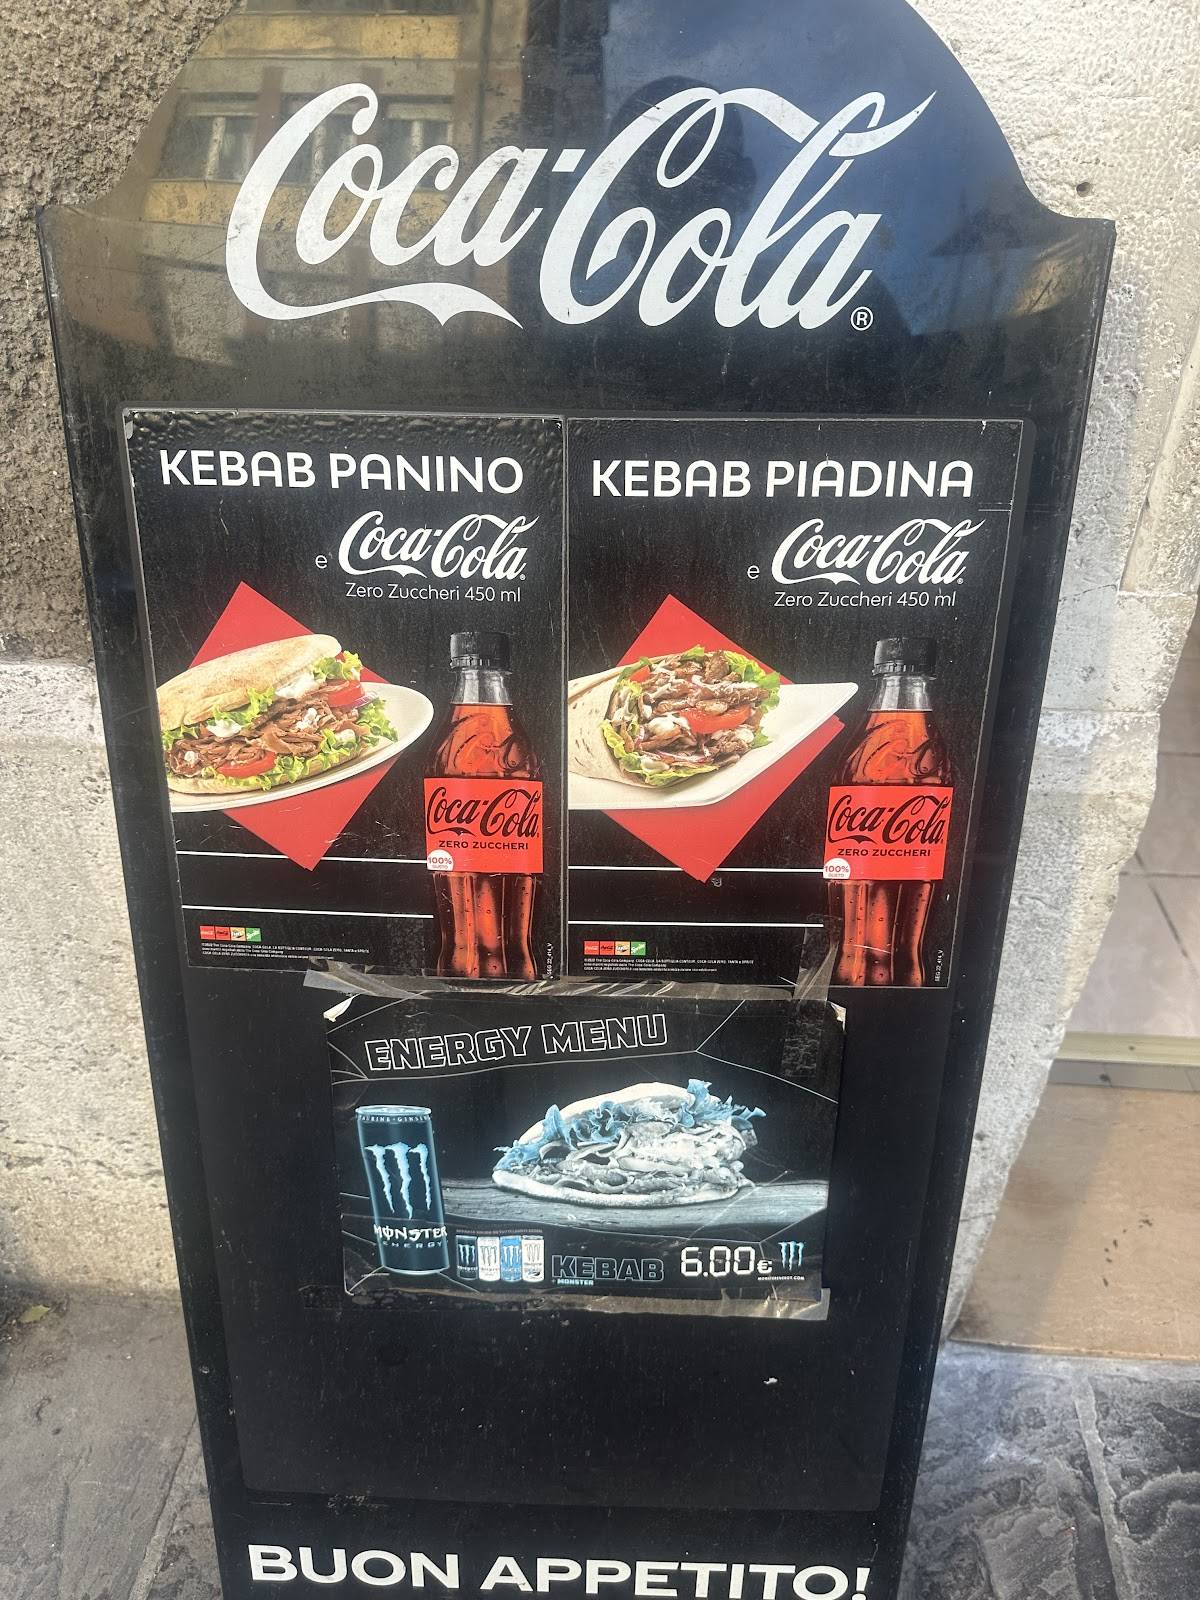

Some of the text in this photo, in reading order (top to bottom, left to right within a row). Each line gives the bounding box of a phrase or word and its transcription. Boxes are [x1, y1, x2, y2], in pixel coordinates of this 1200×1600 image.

[225, 82, 937, 330] Coca-Cola
[159, 449, 524, 493] KEBAB PANINO
[592, 459, 974, 498] KEBAB PIADINA
[315, 510, 540, 580] e Coca-Cola
[747, 518, 986, 585] e Coca-Cola
[345, 582, 521, 602] Zero Zuccheri 450 ml
[774, 591, 956, 608] Zero Zuccheri 450 ml
[427, 787, 541, 838] Coca-Cola
[828, 795, 950, 845] Coca-Cola
[428, 856, 452, 865] 100%
[439, 840, 529, 850] ZERO ZUCCHERI
[837, 848, 931, 857] ZERO ZUCCHERI
[824, 865, 850, 873] 100%
[365, 1013, 667, 1071] ENERGY MENU
[373, 1224, 448, 1242] MONSTER
[551, 1254, 664, 1282] KEBAB
[556, 1278, 594, 1286] MONSTER
[247, 1543, 871, 1600] BUON APPETITO!
